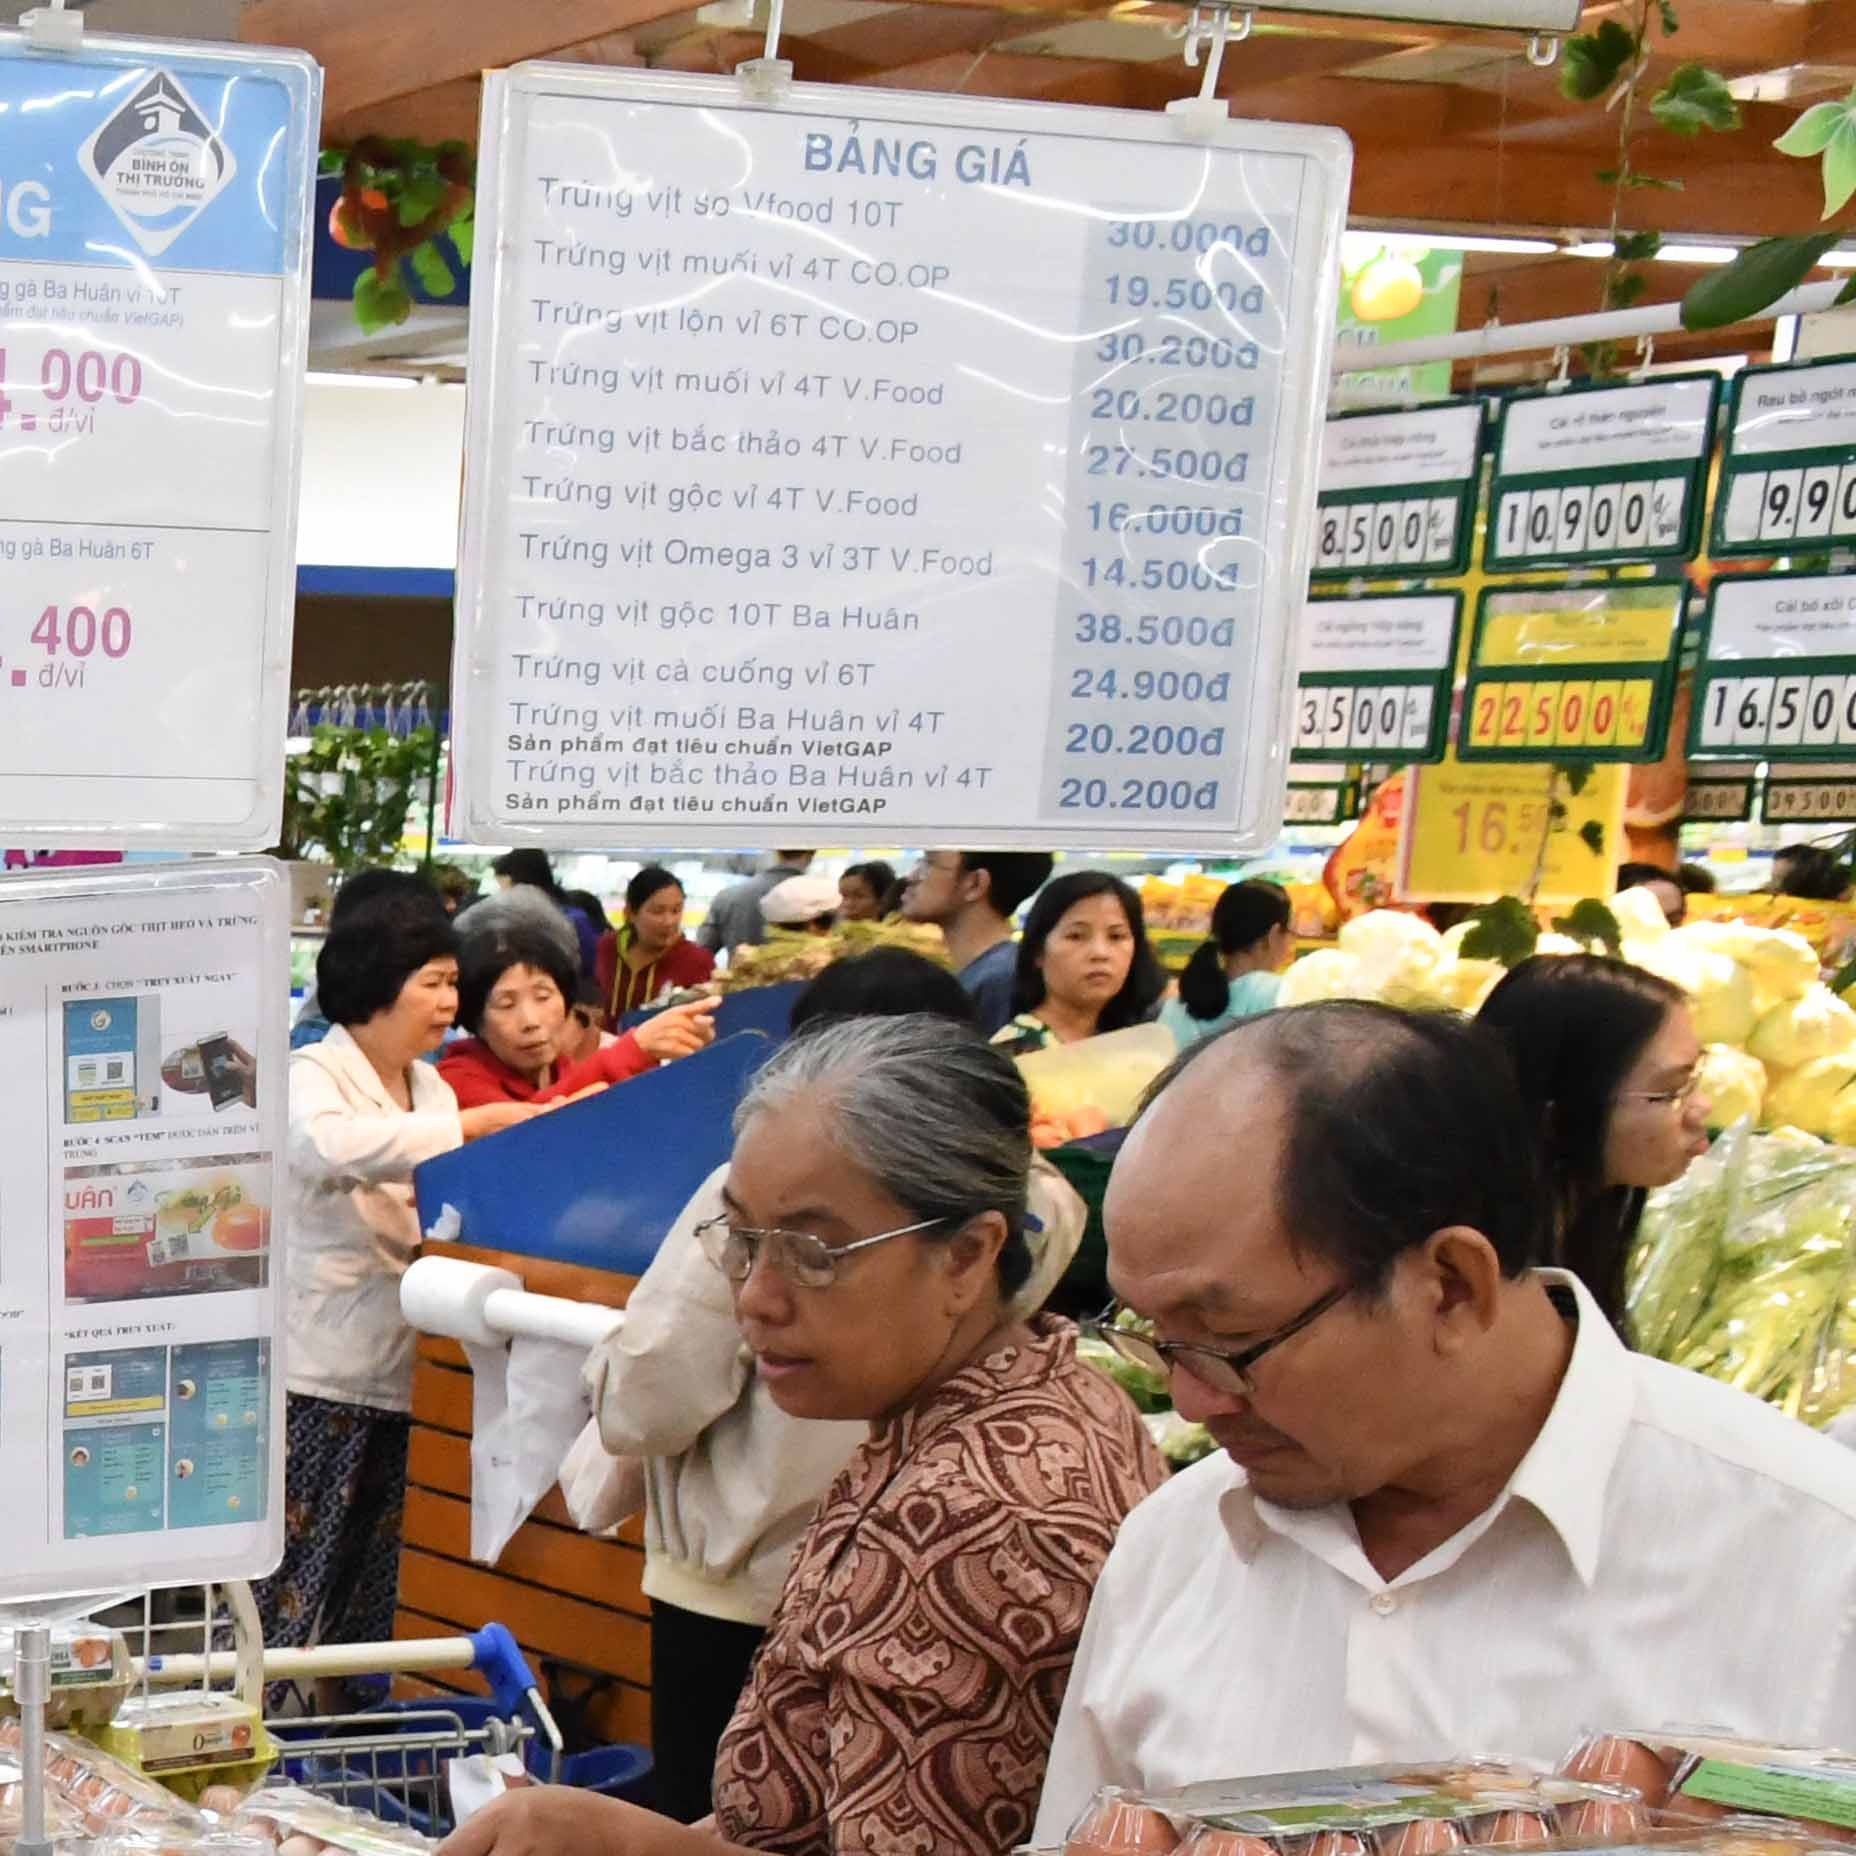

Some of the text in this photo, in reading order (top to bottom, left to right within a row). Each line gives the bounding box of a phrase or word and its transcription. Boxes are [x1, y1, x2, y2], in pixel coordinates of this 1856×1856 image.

[804, 119, 1034, 189] BẢNG GIÁ
[44, 280, 68, 299] Ba
[1096, 334, 1260, 370] 30.200đ
[528, 359, 618, 394] Trứng
[631, 364, 665, 396] vịt
[675, 366, 750, 394] muối
[794, 374, 833, 399] 4T
[843, 376, 945, 406] V.Food
[1091, 388, 1257, 427] 20.200đ
[524, 418, 962, 466] Trứng vịt bắc thảo 4T V.Food
[1088, 445, 1250, 482] 27.500đ
[1086, 499, 1244, 536] 16.000đ
[1507, 493, 1646, 544] 10.900
[21, 536, 44, 560] gà
[49, 537, 74, 558] Ba
[78, 538, 127, 560] Huân
[131, 541, 156, 561] 6T
[519, 531, 609, 569] Trứng
[620, 538, 655, 570] vịt
[664, 538, 771, 573] Omega
[782, 544, 799, 570] 3
[843, 545, 880, 572] 3T
[891, 548, 994, 577] V.Food
[1082, 557, 1241, 592] 14.500đ
[1075, 613, 1236, 648] 38.500đ
[38, 660, 86, 689] đ/vỉ
[1071, 668, 1232, 702] 24.900đ
[510, 700, 599, 733] Trứng
[610, 704, 642, 734] vịt
[654, 703, 727, 730] muối
[737, 707, 775, 731] Ba
[787, 708, 865, 734] Huân
[908, 710, 945, 735] 4T
[1065, 723, 1225, 757] 20.200đ
[1059, 778, 1219, 811] 20.200đ
